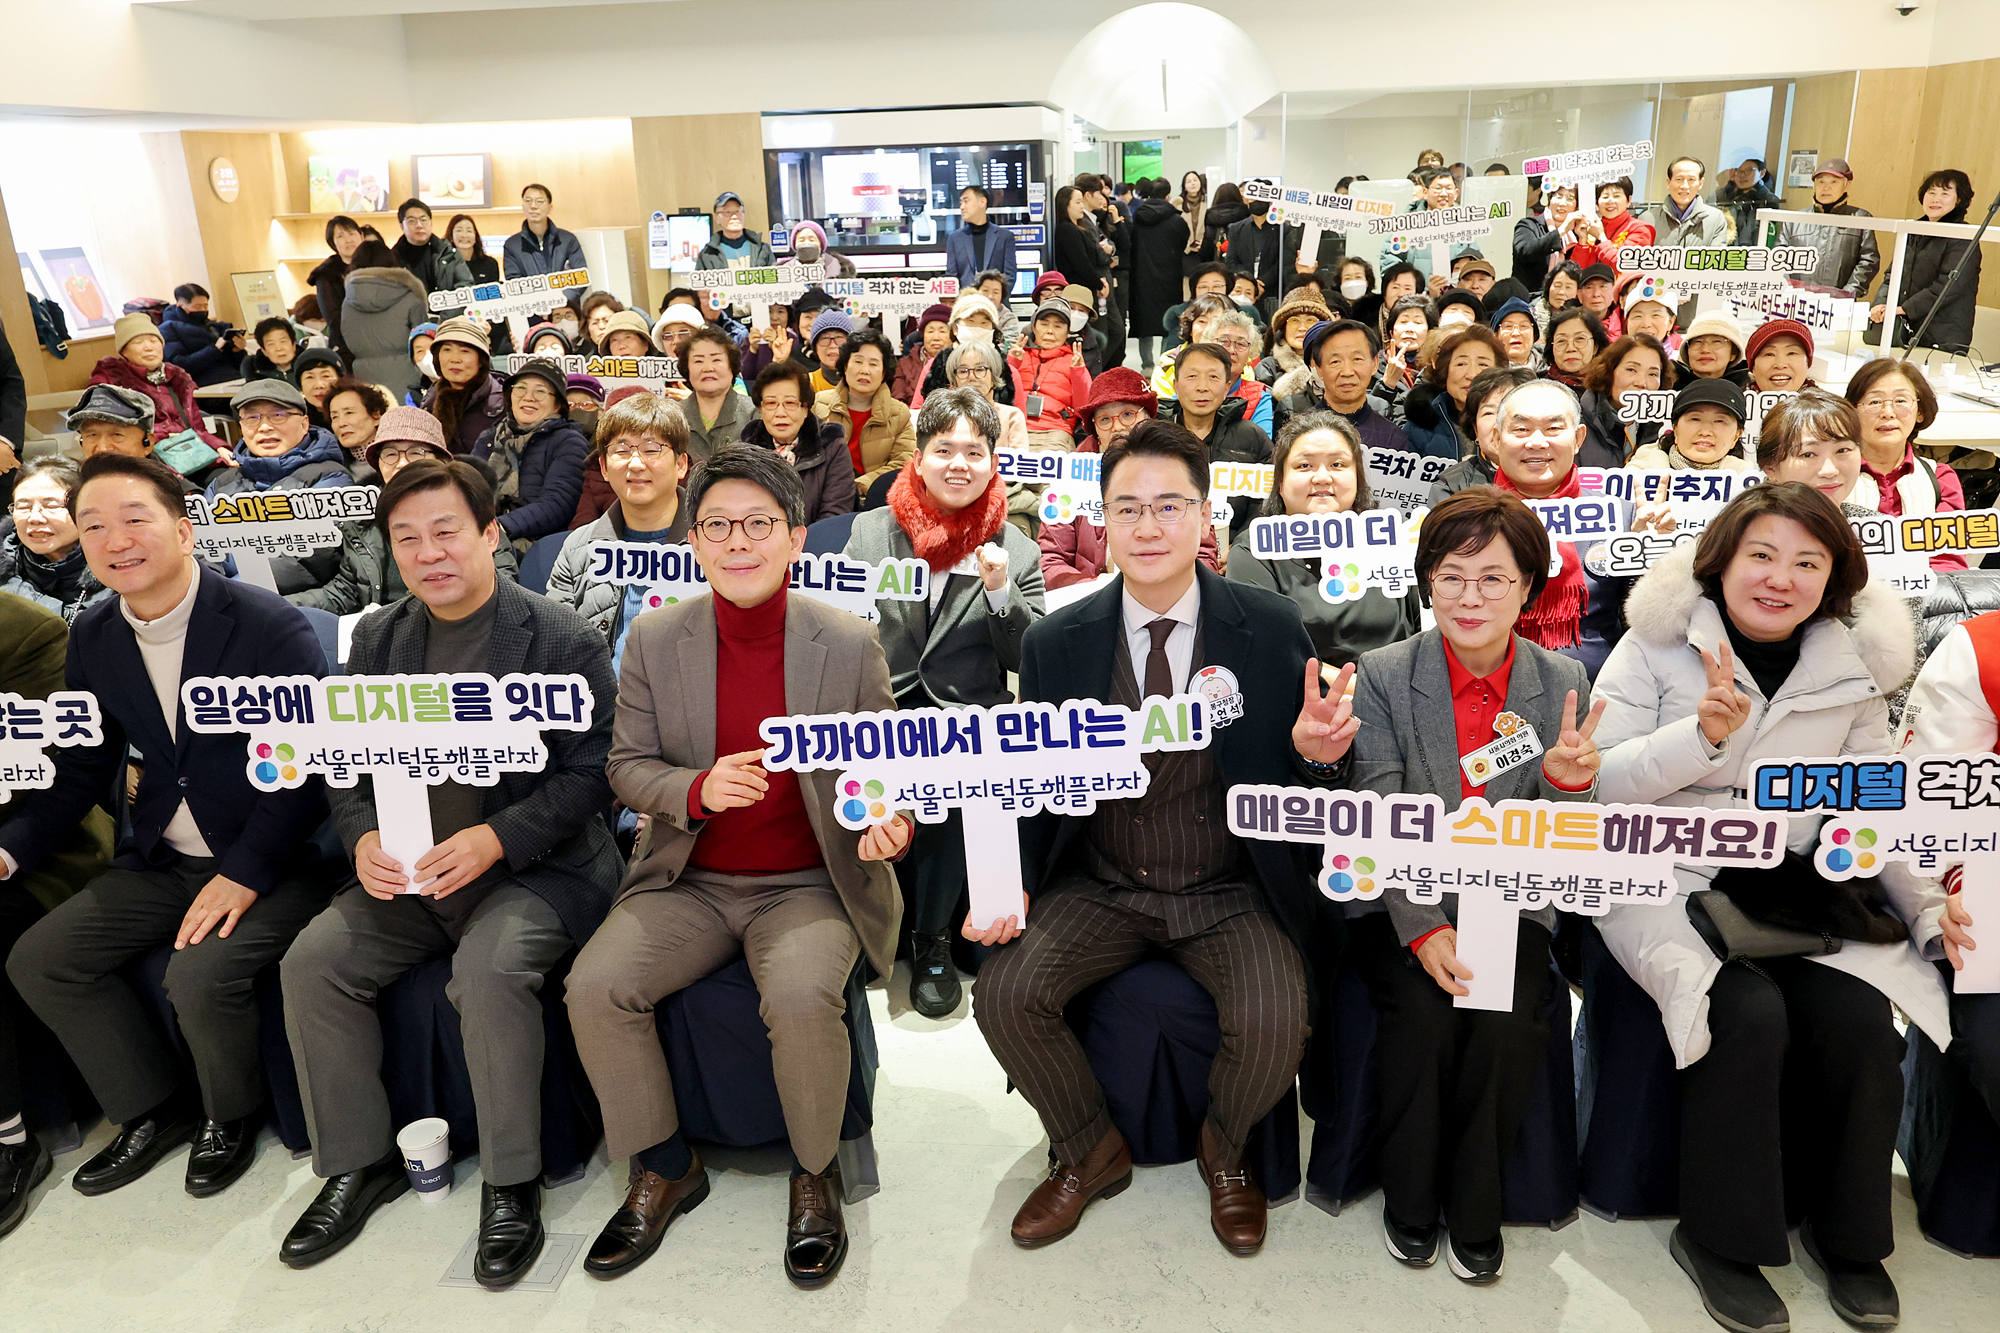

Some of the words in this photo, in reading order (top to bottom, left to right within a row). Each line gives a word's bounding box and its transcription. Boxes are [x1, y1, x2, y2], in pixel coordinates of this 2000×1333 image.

[1525, 157, 1562, 175] 배움이
[1565, 149, 1603, 169] 멈추지
[1607, 146, 1633, 162] 않는
[1636, 142, 1652, 159] 곳
[1246, 183, 1283, 201] 오늘의
[1285, 189, 1313, 207] 배움,
[1316, 194, 1353, 211] 내일의
[1356, 199, 1394, 216] 디지털
[1286, 211, 1362, 231] 서울디지털동행플라자
[1368, 210, 1439, 235] 가까이에서
[1442, 205, 1486, 225] 만나는
[1488, 201, 1512, 219] AI!
[1409, 228, 1490, 248] 서울디지털동행플라자
[1619, 248, 1681, 271] 일상에
[1684, 248, 1768, 271] 디지털을
[1771, 249, 1818, 271] 잇다
[430, 291, 472, 309] 오늘의
[473, 284, 506, 301] 배움,
[506, 277, 548, 296] 내일의
[549, 270, 589, 289] 디지털
[690, 270, 733, 288] 일상에
[735, 267, 792, 286] 디지털을
[794, 265, 825, 283] 잇다
[825, 281, 864, 295] 디지털
[869, 281, 895, 295] 격차
[899, 281, 925, 295] 없는
[929, 280, 957, 294] 서울
[1667, 281, 1784, 298] 서울디지털동행플라자
[485, 298, 565, 320] 서울디지털동행플라자
[862, 302, 937, 315] 서울디지털동행플라
[999, 453, 1062, 480] 오늘의
[1369, 452, 1416, 479] 격차
[1257, 517, 1355, 553] 매일이
[1365, 514, 1397, 545] 더
[1901, 513, 2000, 551] 디지털
[876, 564, 923, 596] AI!
[55, 700, 94, 739] 곳
[190, 683, 315, 725] 일상에
[326, 681, 494, 724] 디지털을
[505, 682, 585, 723] 잇다
[769, 715, 982, 764] 가까이에서
[999, 707, 1126, 753] 만나는
[1141, 702, 1203, 745] AI!
[304, 746, 539, 780] 서울디지털동행플라자
[1495, 743, 1534, 769] 이경숙
[895, 771, 1142, 817] 서울디지털동행플라자
[1755, 761, 1907, 812] 디지털
[1236, 792, 1372, 839] 매일이
[1390, 802, 1434, 843] 더
[1450, 806, 1776, 861] 스마트해져요!
[1385, 866, 1669, 907] 서울디지털동행플라자
